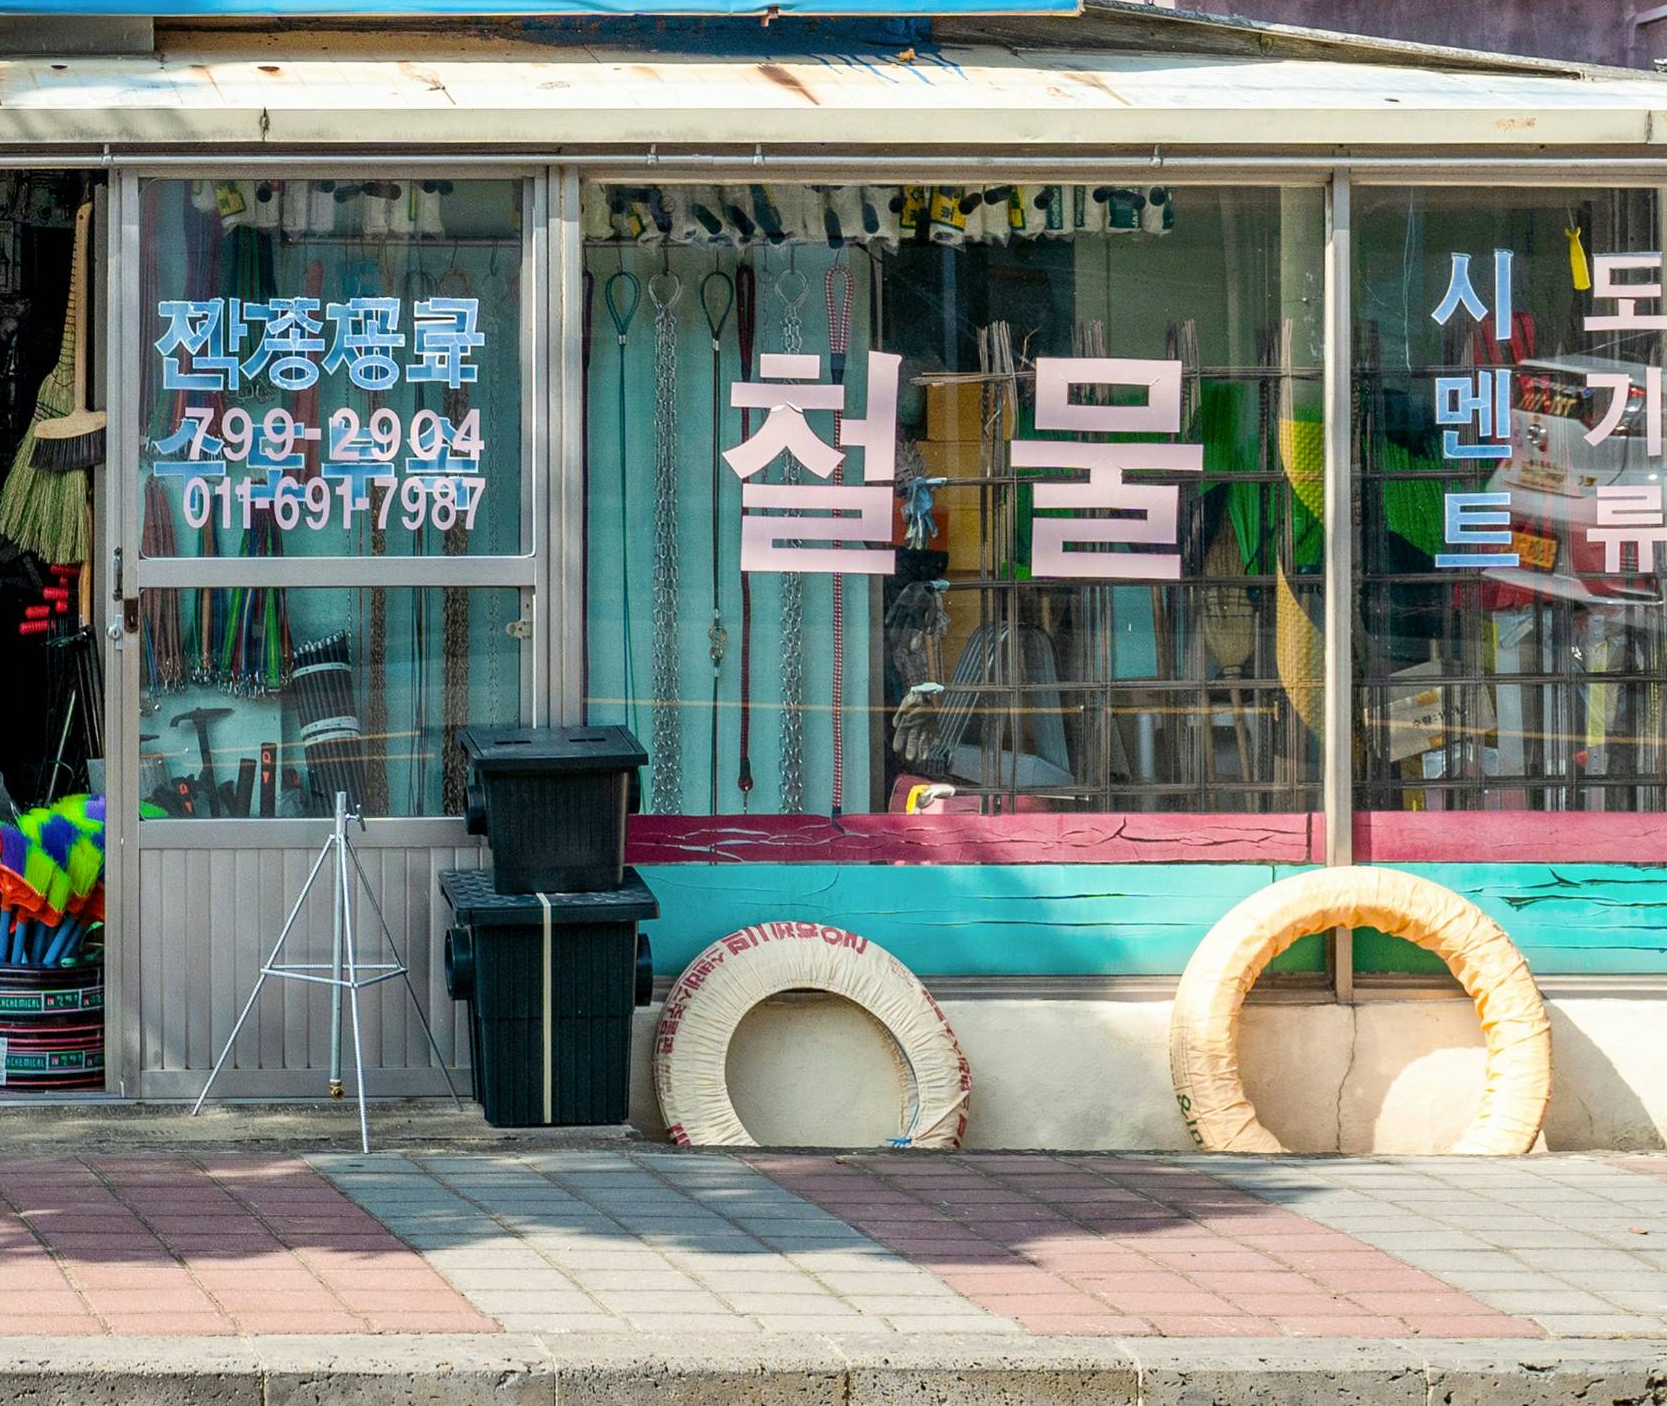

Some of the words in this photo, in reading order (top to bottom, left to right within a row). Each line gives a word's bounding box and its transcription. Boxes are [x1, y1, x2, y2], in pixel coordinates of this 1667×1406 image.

[182, 476, 486, 531] 011-691-7987
[185, 407, 485, 462] 799-2904
[721, 349, 1204, 580] 철물
[1430, 248, 1520, 570] 시멘트
[1582, 250, 1667, 575] 도기류
